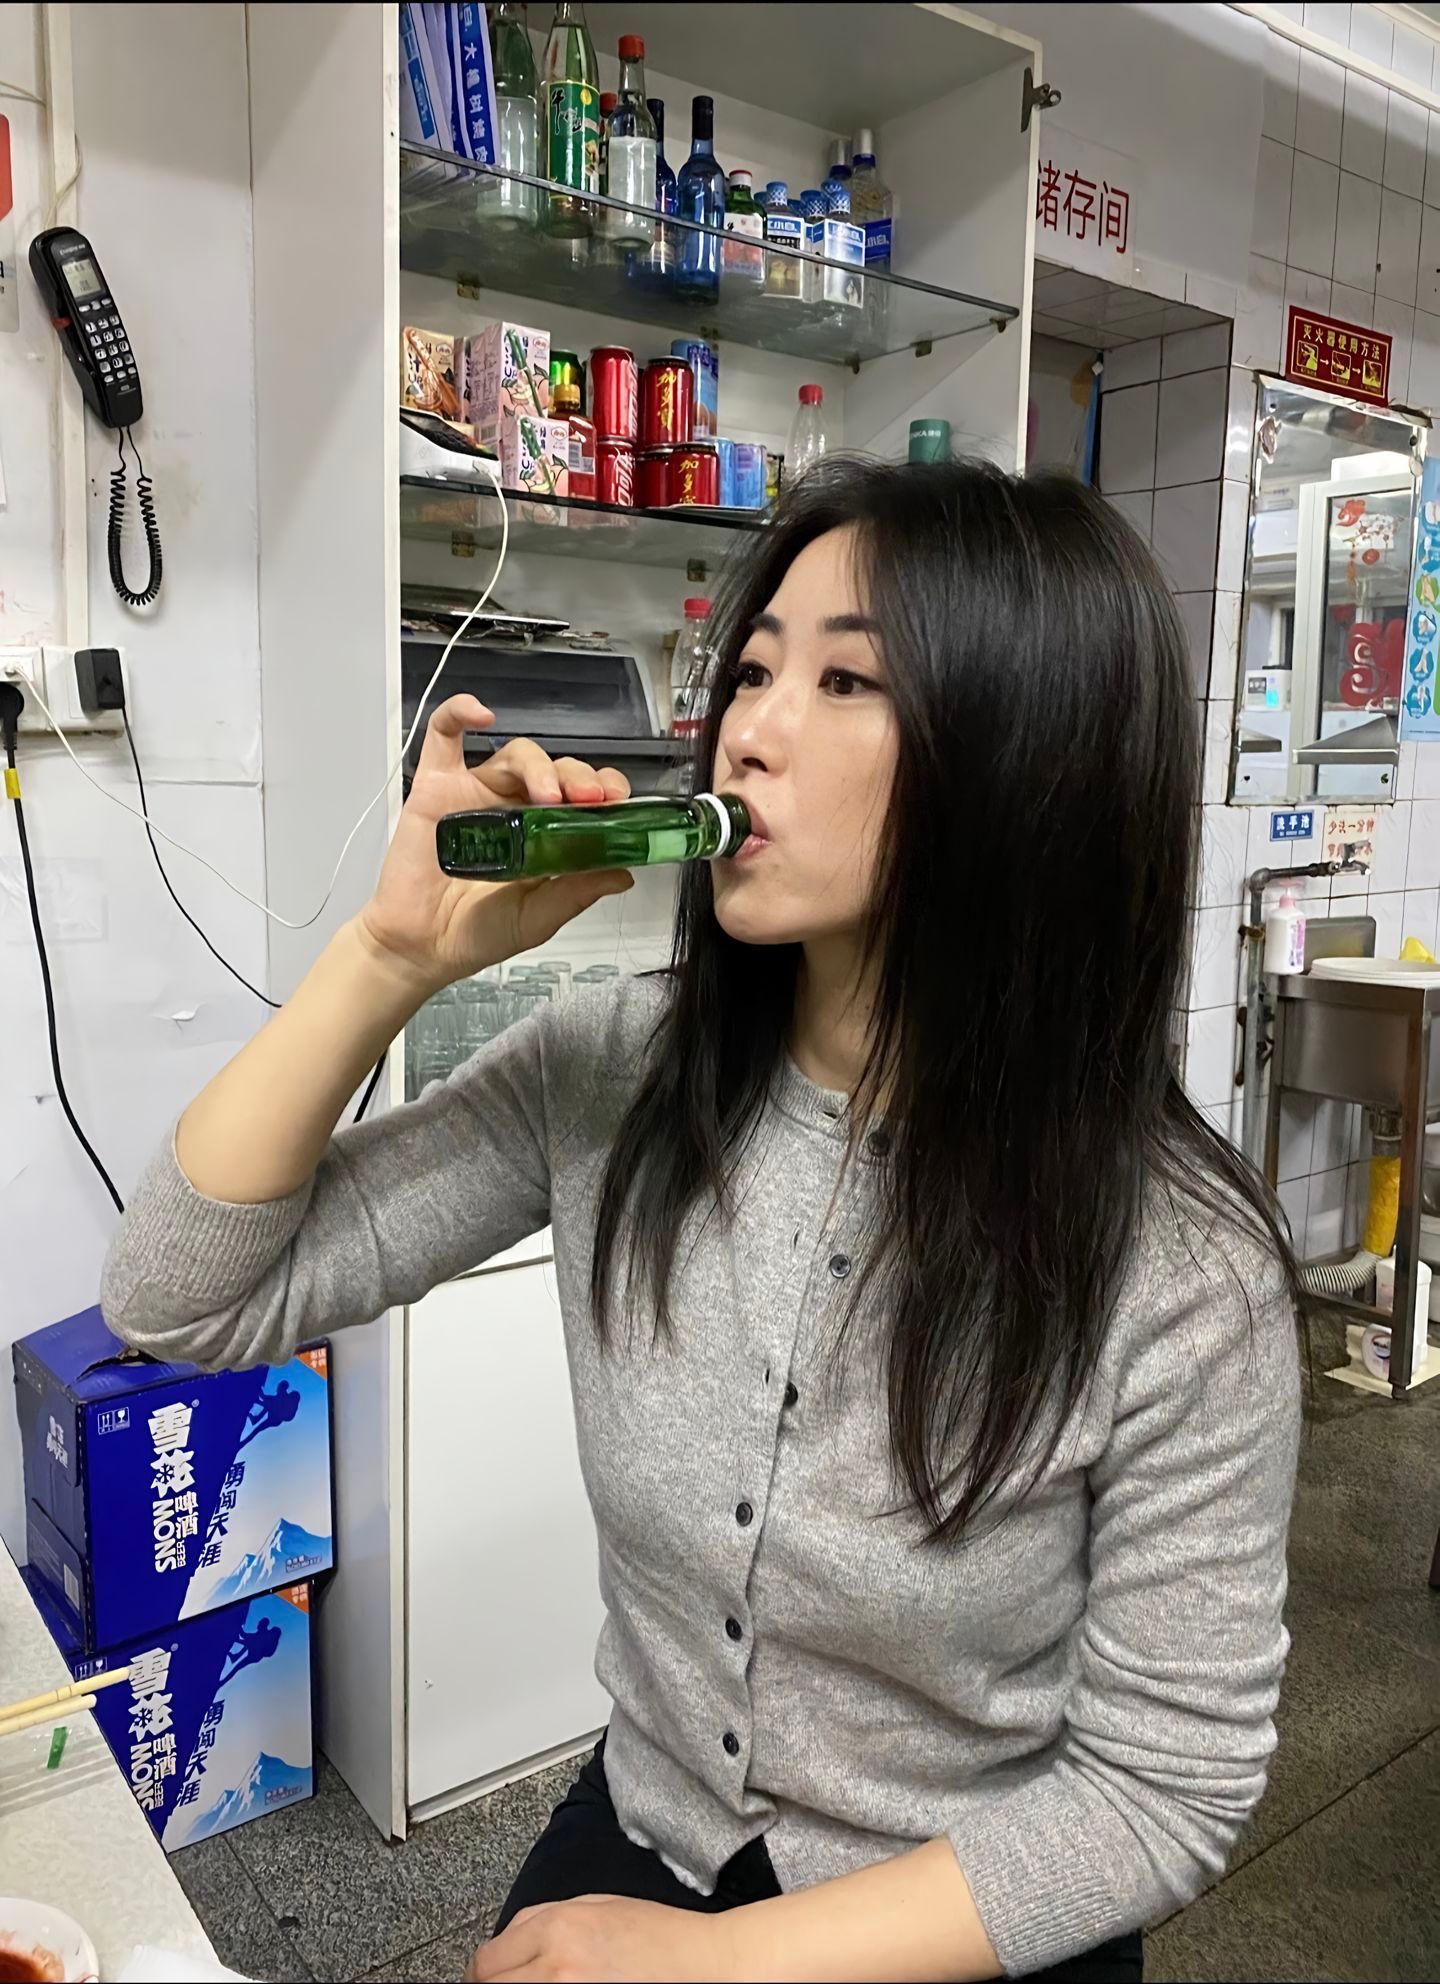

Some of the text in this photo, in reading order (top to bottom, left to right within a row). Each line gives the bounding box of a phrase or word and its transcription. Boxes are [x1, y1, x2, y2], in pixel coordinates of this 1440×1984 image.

[1303, 323, 1380, 360] 灭火器使用方法
[147, 1402, 196, 1498] 雪花
[152, 1498, 178, 1573] SNOW
[174, 1490, 199, 1539] 啤酒
[199, 1461, 246, 1568] 勇闯天涯
[176, 1540, 187, 1568] BEER
[128, 1647, 173, 1742] 雪花
[153, 1733, 178, 1779] 啤酒
[178, 1699, 226, 1807] 勇闯天涯
